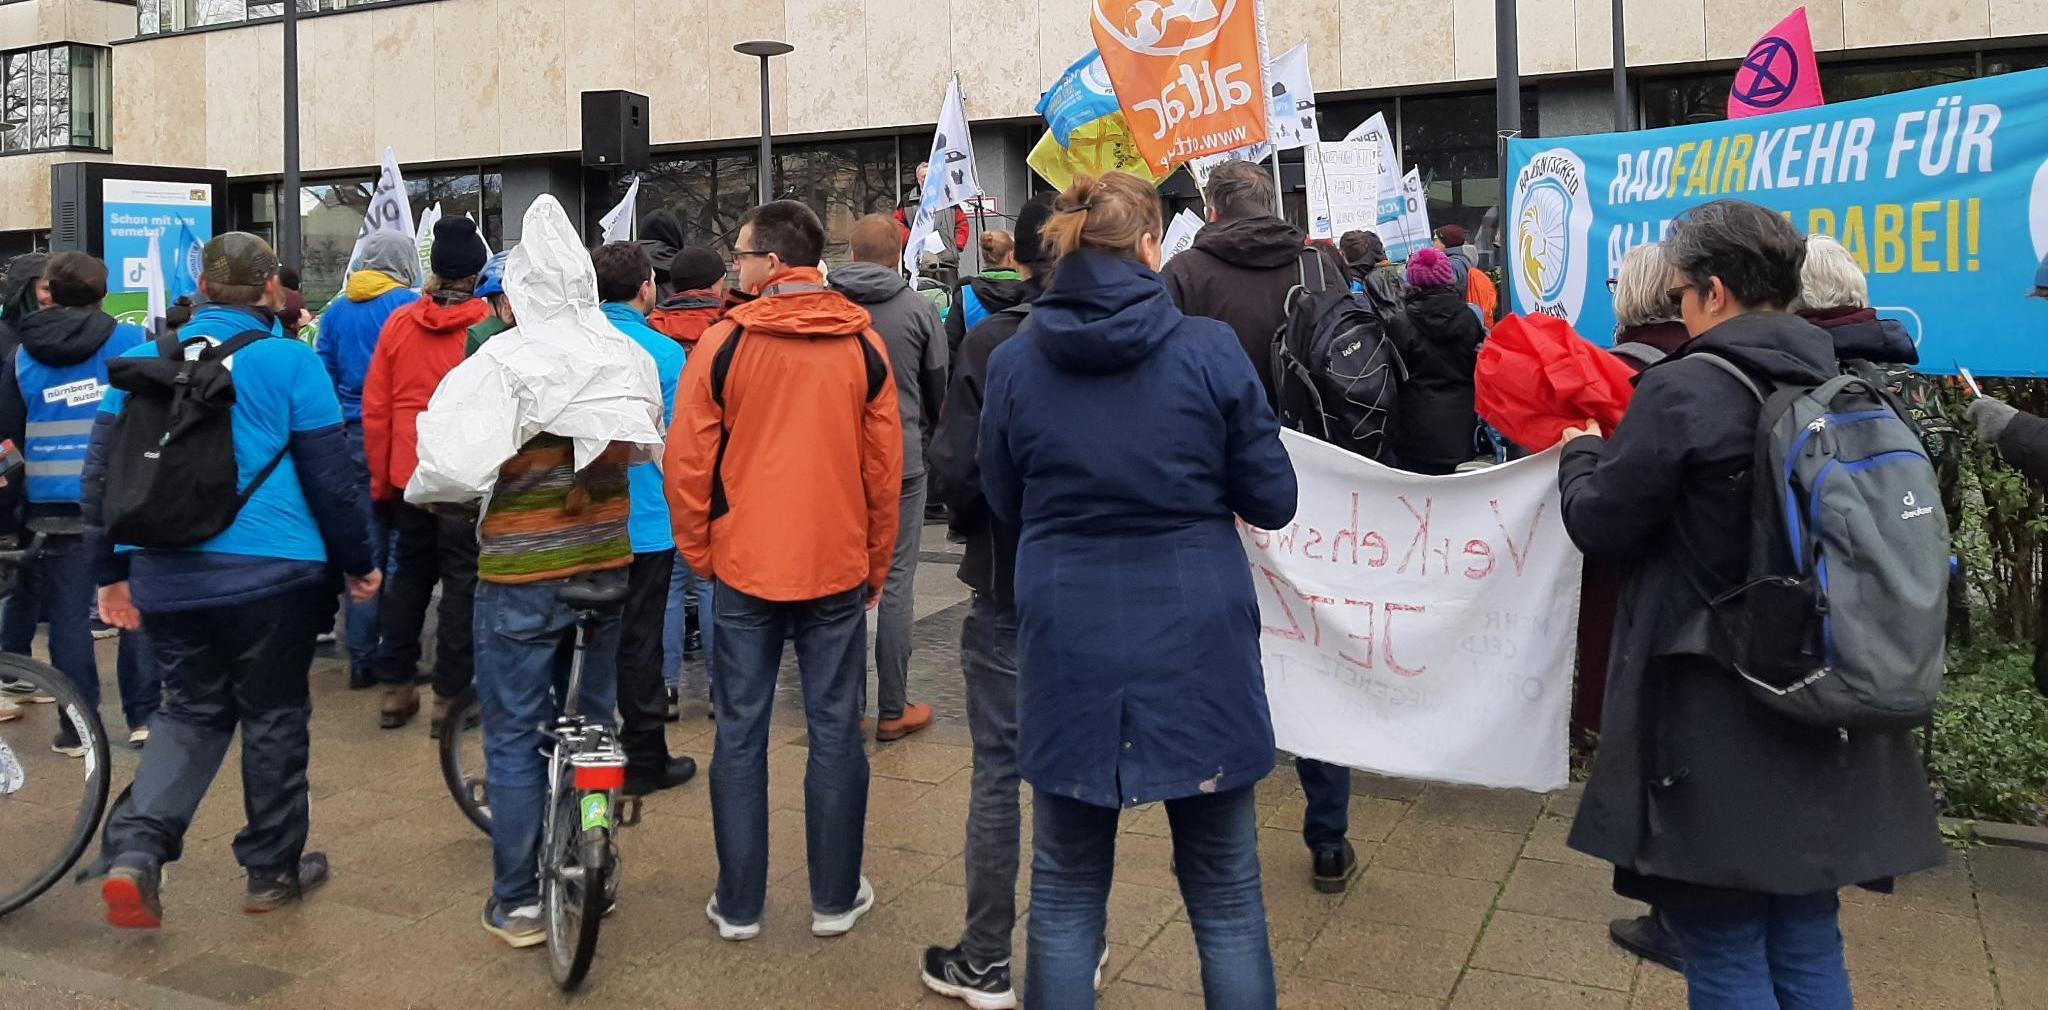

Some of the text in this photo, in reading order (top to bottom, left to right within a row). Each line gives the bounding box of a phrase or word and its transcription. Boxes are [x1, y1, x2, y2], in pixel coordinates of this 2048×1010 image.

[1609, 95, 2002, 206] RADFAIRKEHR FÜR
[110, 212, 149, 225] Schon
[151, 214, 172, 226] mit
[47, 382, 95, 398] nürnberg
